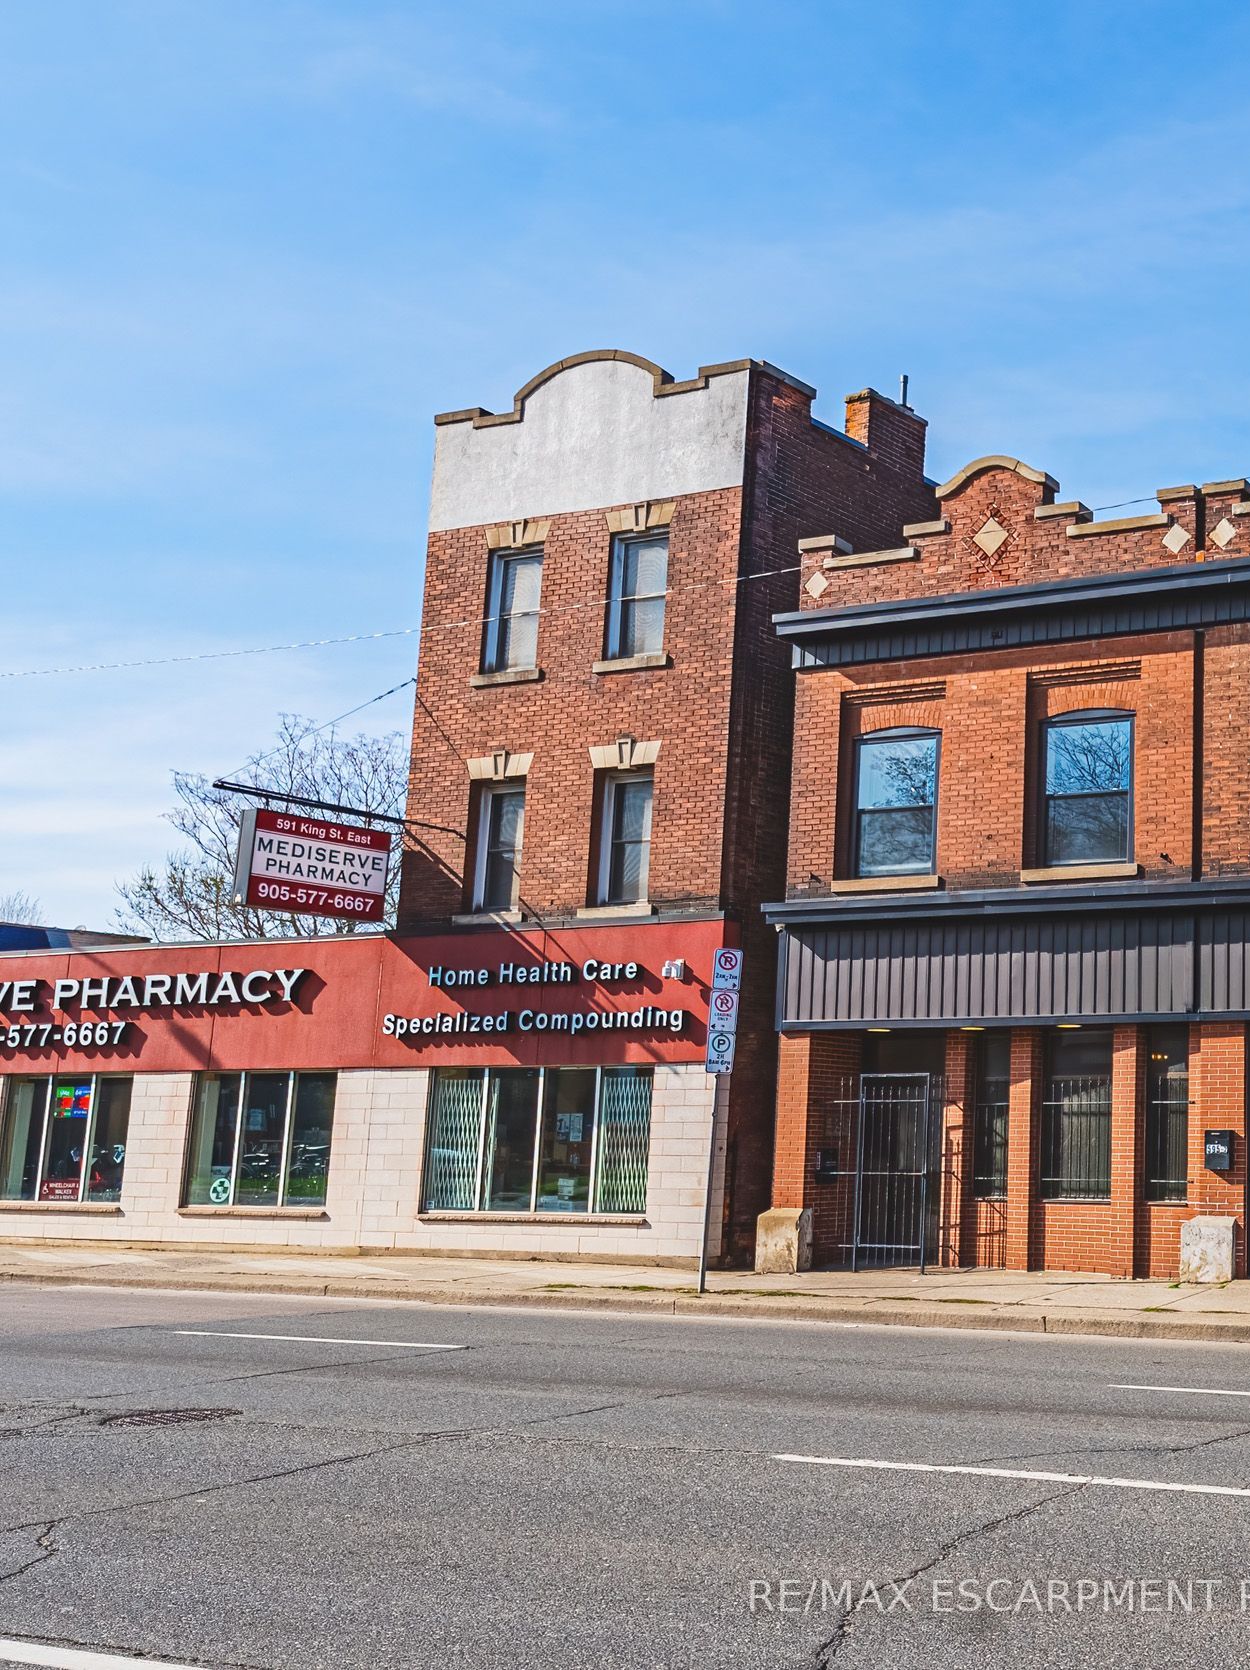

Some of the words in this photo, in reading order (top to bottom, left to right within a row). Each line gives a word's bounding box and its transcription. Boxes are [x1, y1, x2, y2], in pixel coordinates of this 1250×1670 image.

[276, 819, 296, 831] 591
[300, 823, 326, 839] King
[329, 828, 344, 840] St.
[347, 832, 371, 845] East
[257, 837, 384, 872] MEDISERVE
[265, 857, 373, 887] PHARMACY
[258, 883, 374, 913] 905-577-6667
[428, 965, 489, 987] Home
[499, 961, 572, 984] Health
[582, 958, 638, 981] Care
[52, 968, 305, 1011] PHARMACY
[382, 1011, 508, 1039] Specialized
[518, 1006, 683, 1035] Compounding
